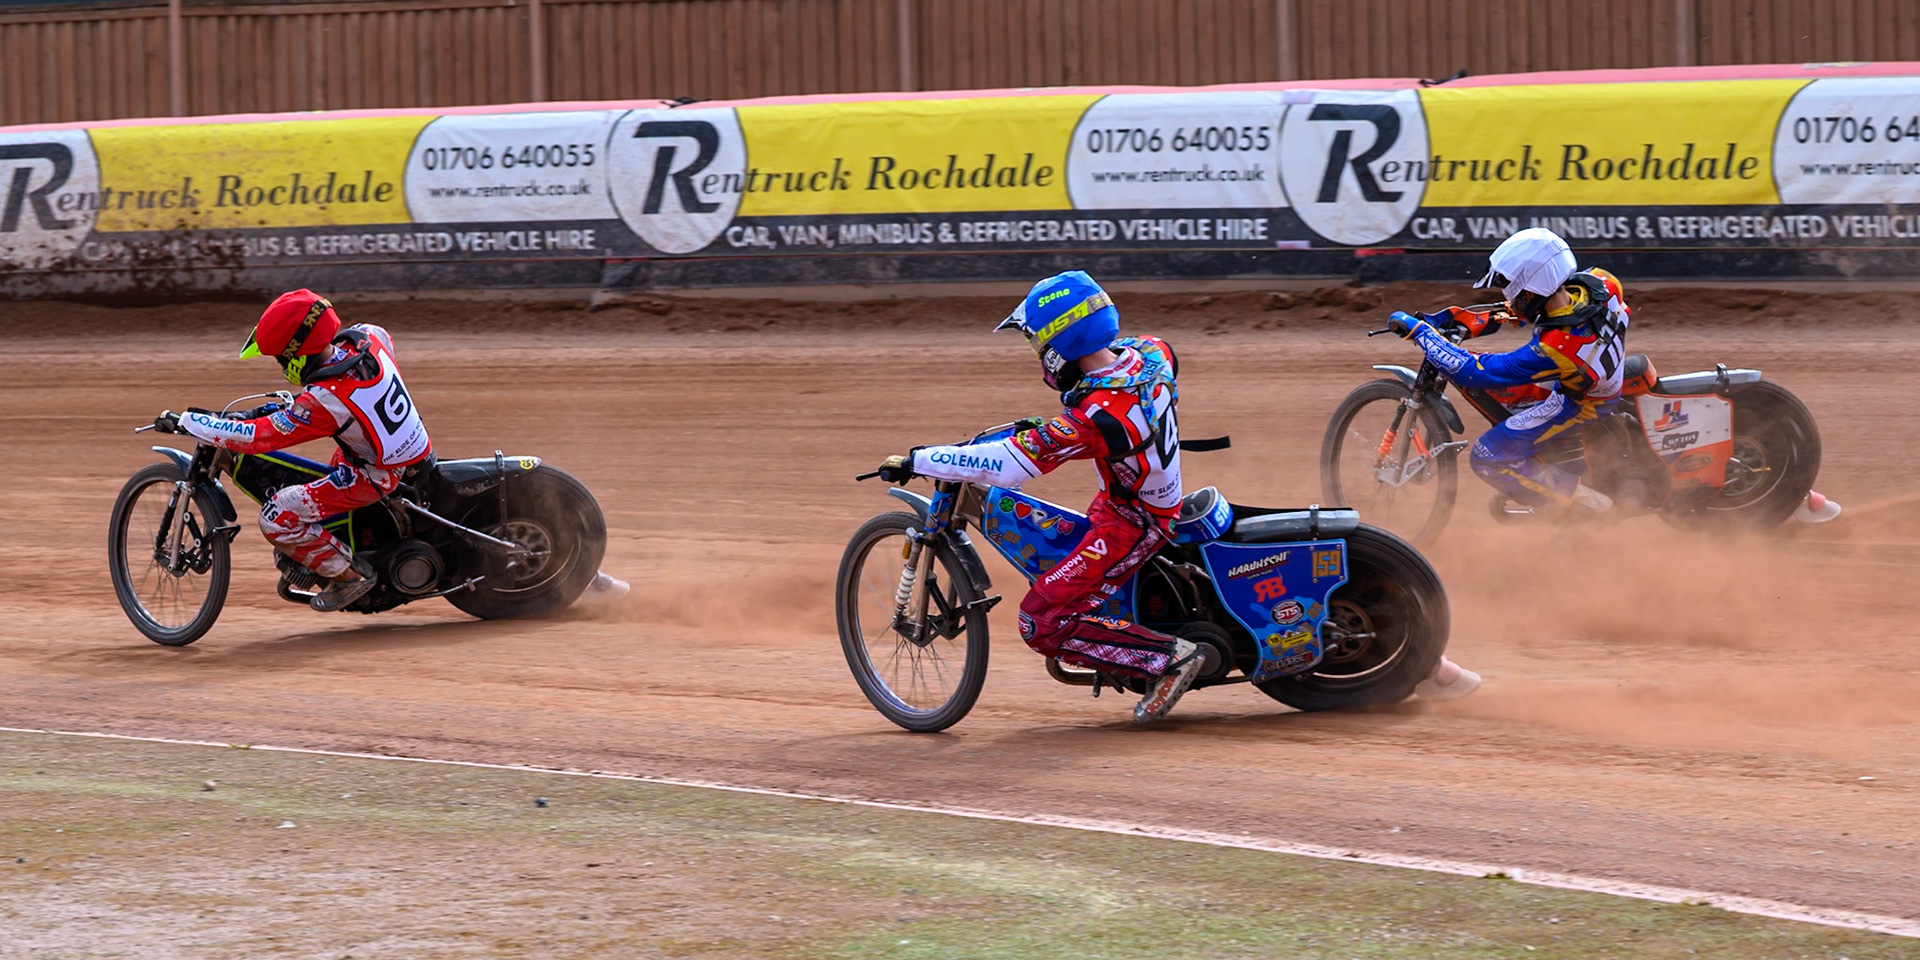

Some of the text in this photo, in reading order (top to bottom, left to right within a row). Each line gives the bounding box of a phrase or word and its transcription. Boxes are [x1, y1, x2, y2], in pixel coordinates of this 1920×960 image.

[1087, 126, 1271, 153] 01706 640055
[1794, 116, 1877, 143] 01706
[423, 144, 596, 171] 01706 640055
[1307, 103, 1760, 204] Rentruck Rochdale
[632, 120, 1055, 215] Rentruck Rochdale
[1091, 163, 1266, 183] www.rentruck.co.uk
[0, 142, 395, 233] Rentruck Rochdale
[427, 179, 592, 198] www.rentruck.co.uk
[284, 236, 302, 256] &
[303, 232, 453, 256] REFRIGERATED
[454, 230, 542, 252] VEHICLE
[545, 229, 597, 250] HIRE
[725, 225, 776, 249] CAR,
[838, 222, 934, 245] MINIBUS
[937, 222, 956, 243] &
[958, 218, 1117, 243] REFRIGERATED
[1118, 218, 1211, 241] VEHICLE
[1215, 217, 1269, 241] HIRE
[1411, 217, 1464, 243] CAR,
[1635, 216, 1656, 239] &
[1657, 215, 1829, 239] REFRIGERATED
[384, 381, 409, 423] 6
[190, 412, 255, 437] COLEMAN
[930, 451, 1003, 473] COLEMAN
[1312, 550, 1341, 578] 159
[1277, 605, 1298, 619] STS
